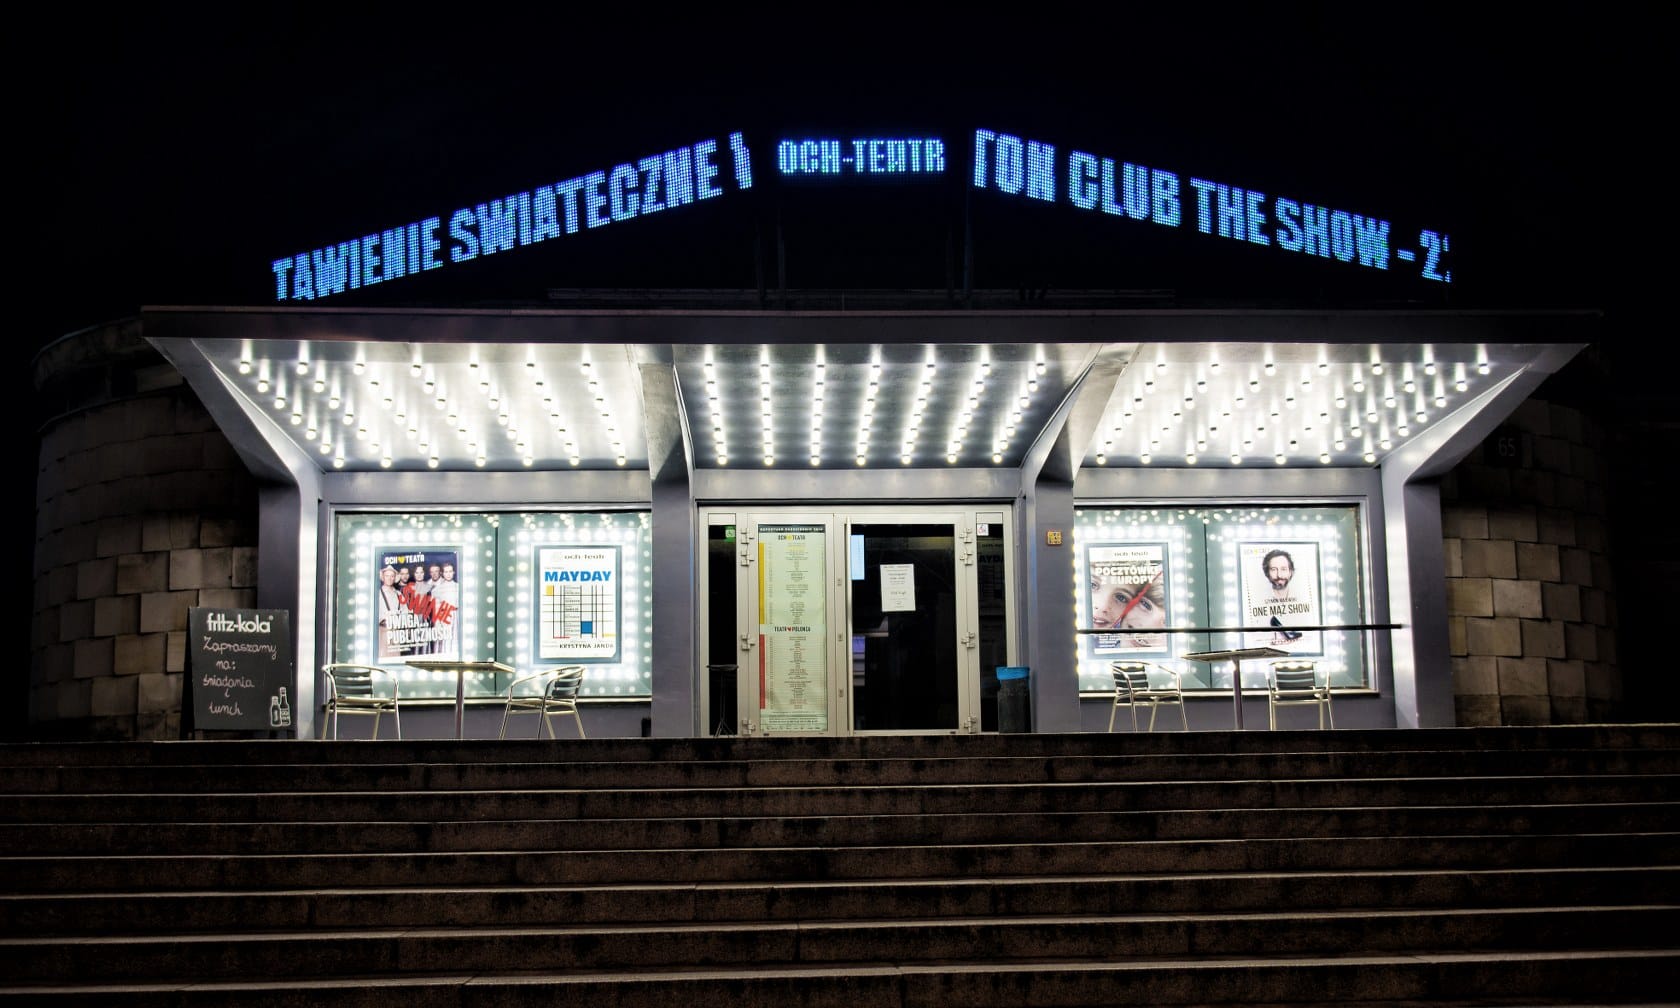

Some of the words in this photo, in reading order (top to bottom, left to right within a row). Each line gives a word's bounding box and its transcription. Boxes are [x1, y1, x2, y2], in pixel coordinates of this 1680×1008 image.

[776, 136, 947, 176] OCH-TEATR
[448, 138, 723, 263] SWIATECZNE
[1068, 150, 1182, 228] CLUB
[1189, 176, 1271, 246] THE
[1274, 197, 1390, 270] SHOW
[384, 556, 398, 565] OCH
[405, 554, 425, 564] TEATR
[544, 570, 612, 582] MAYDAY
[1111, 575, 1153, 585] EUROPY
[1252, 606, 1268, 617] ONE
[1288, 603, 1310, 614] SHOW
[206, 612, 271, 633] fritz-kola
[202, 636, 277, 660] Zapraszamy
